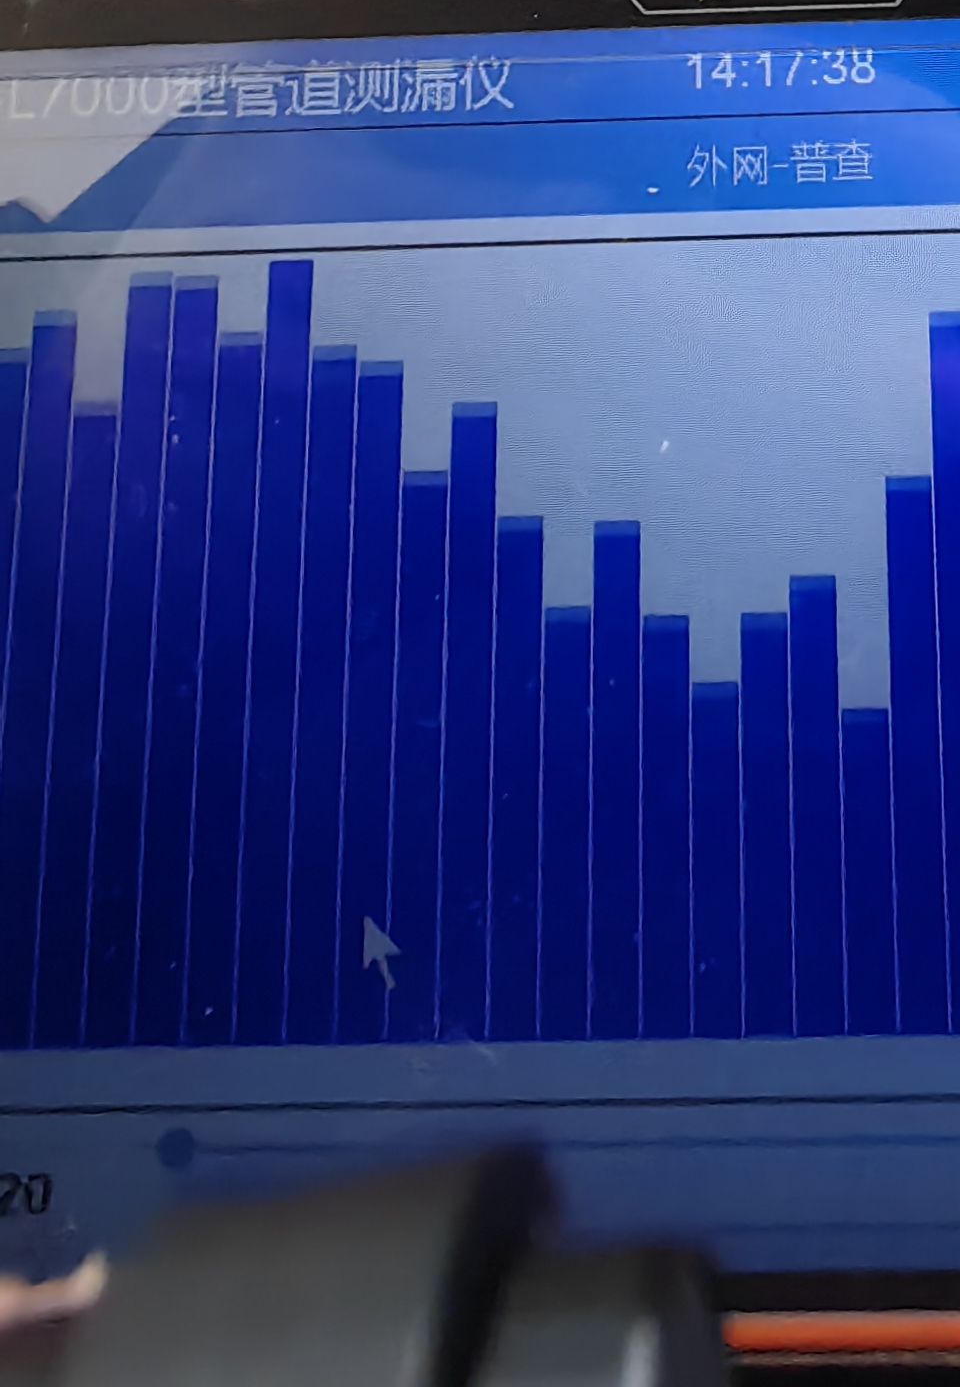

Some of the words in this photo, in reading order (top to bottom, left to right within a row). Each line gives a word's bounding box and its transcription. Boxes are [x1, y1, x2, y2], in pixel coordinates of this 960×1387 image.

[686, 47, 876, 91] 14:17:38
[686, 138, 875, 189] 外网-普查
